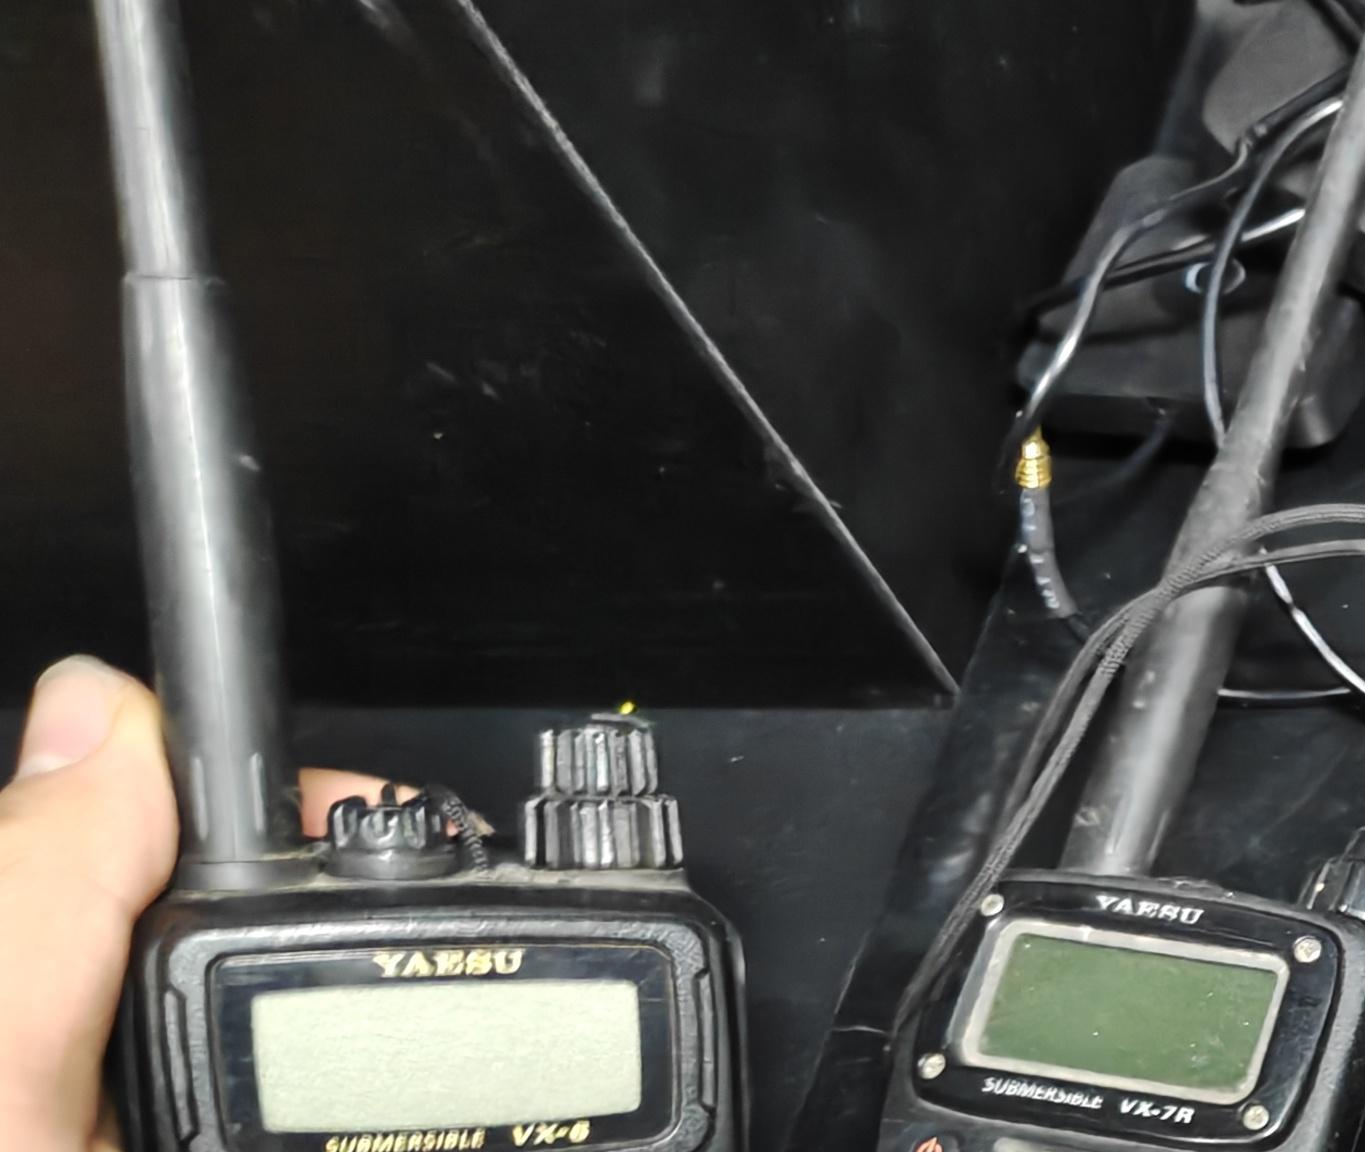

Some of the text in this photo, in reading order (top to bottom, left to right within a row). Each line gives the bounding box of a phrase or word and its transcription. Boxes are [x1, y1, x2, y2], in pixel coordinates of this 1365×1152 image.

[1096, 896, 1204, 924] YAESU
[373, 949, 525, 977] YAESU
[982, 1076, 1196, 1123] SUBMERSIBLE VX-7R
